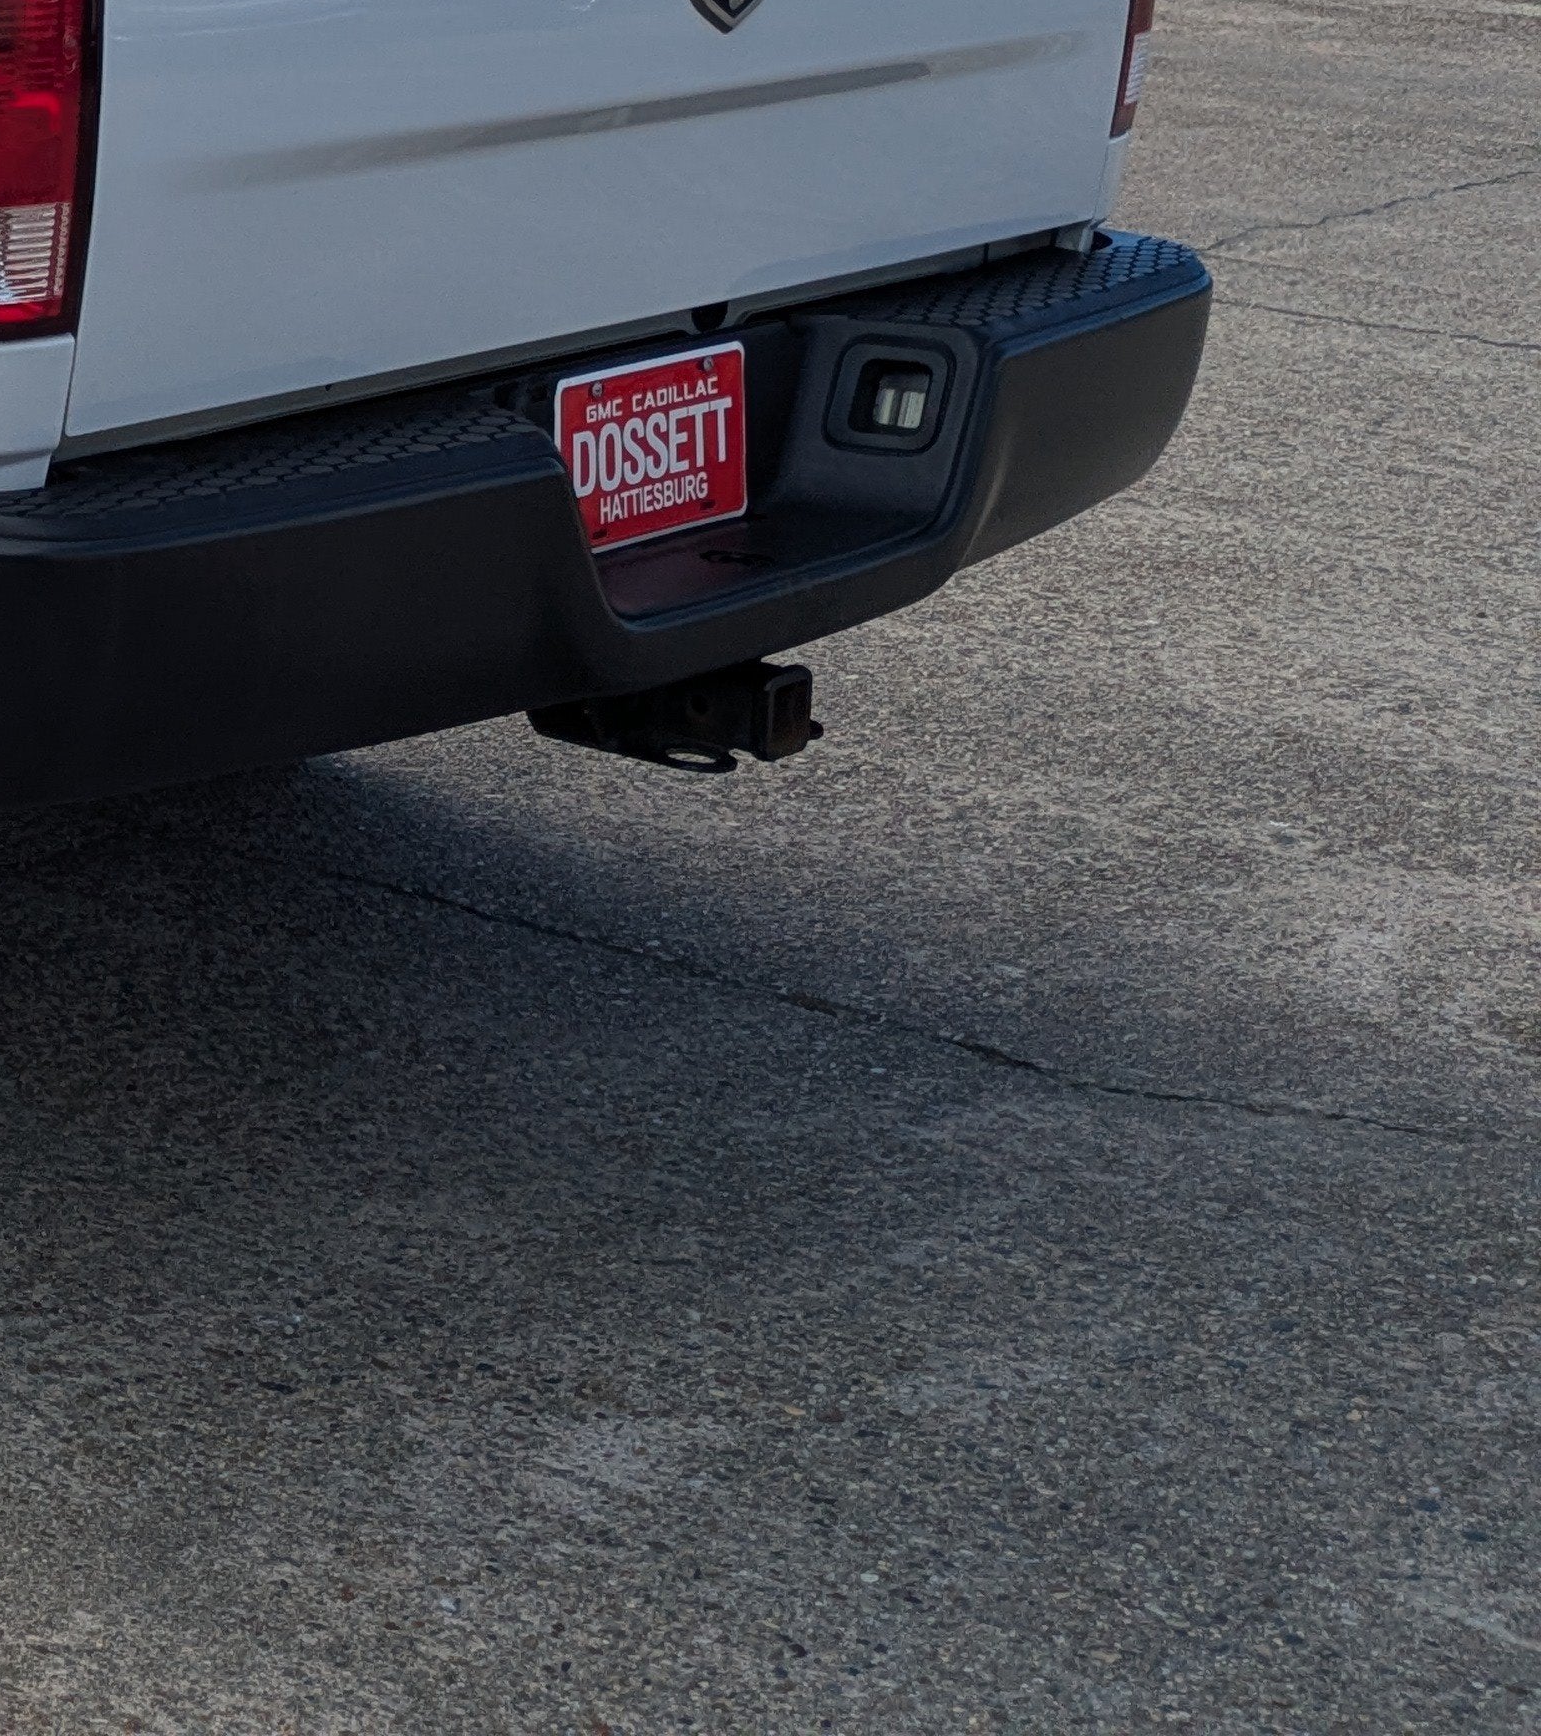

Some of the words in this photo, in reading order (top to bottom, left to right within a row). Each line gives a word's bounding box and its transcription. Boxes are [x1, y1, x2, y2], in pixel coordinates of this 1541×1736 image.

[585, 398, 623, 424] GMC
[631, 375, 720, 413] CADILLAC
[572, 396, 733, 499] DOSSETT
[599, 472, 710, 525] HATTIESBURG
